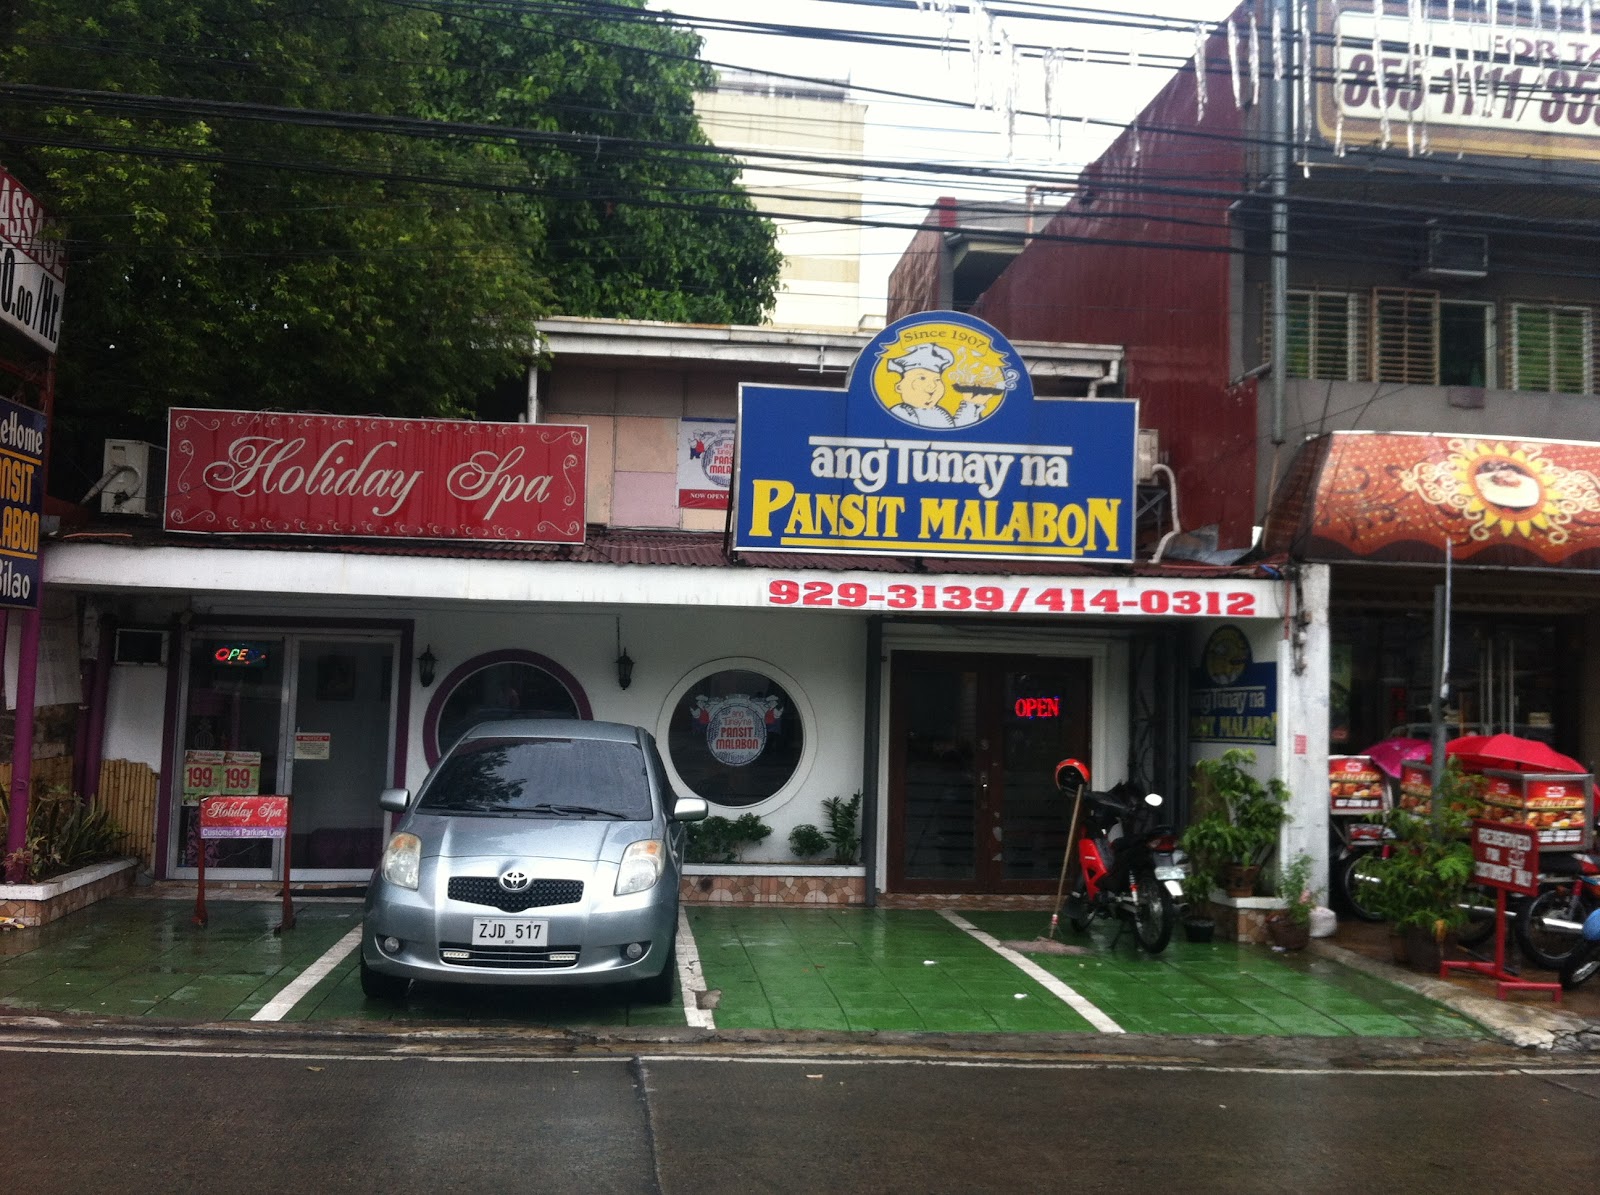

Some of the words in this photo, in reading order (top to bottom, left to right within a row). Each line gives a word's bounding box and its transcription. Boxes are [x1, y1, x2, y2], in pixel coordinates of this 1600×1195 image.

[903, 330, 947, 342] Since
[952, 330, 987, 348] 1907
[203, 436, 424, 517] Holiday
[447, 445, 554, 521] Spa
[810, 446, 889, 493] ang
[888, 441, 1014, 499] Tunay
[1020, 455, 1069, 488] na
[748, 479, 906, 538] PANSIT
[917, 497, 1122, 552] MALABON
[768, 580, 1256, 616] 929-3139/414-0312
[1015, 697, 1060, 717] OPEN
[720, 727, 753, 738] PANSIT
[716, 738, 759, 750] MALABON
[187, 767, 213, 788] 199
[225, 768, 251, 789] 199
[206, 801, 254, 823] Holiday
[257, 801, 283, 823] Spa
[241, 828, 268, 838] Parking
[268, 828, 286, 837] Only
[479, 922, 506, 939] ZJD
[515, 923, 542, 939] 517
